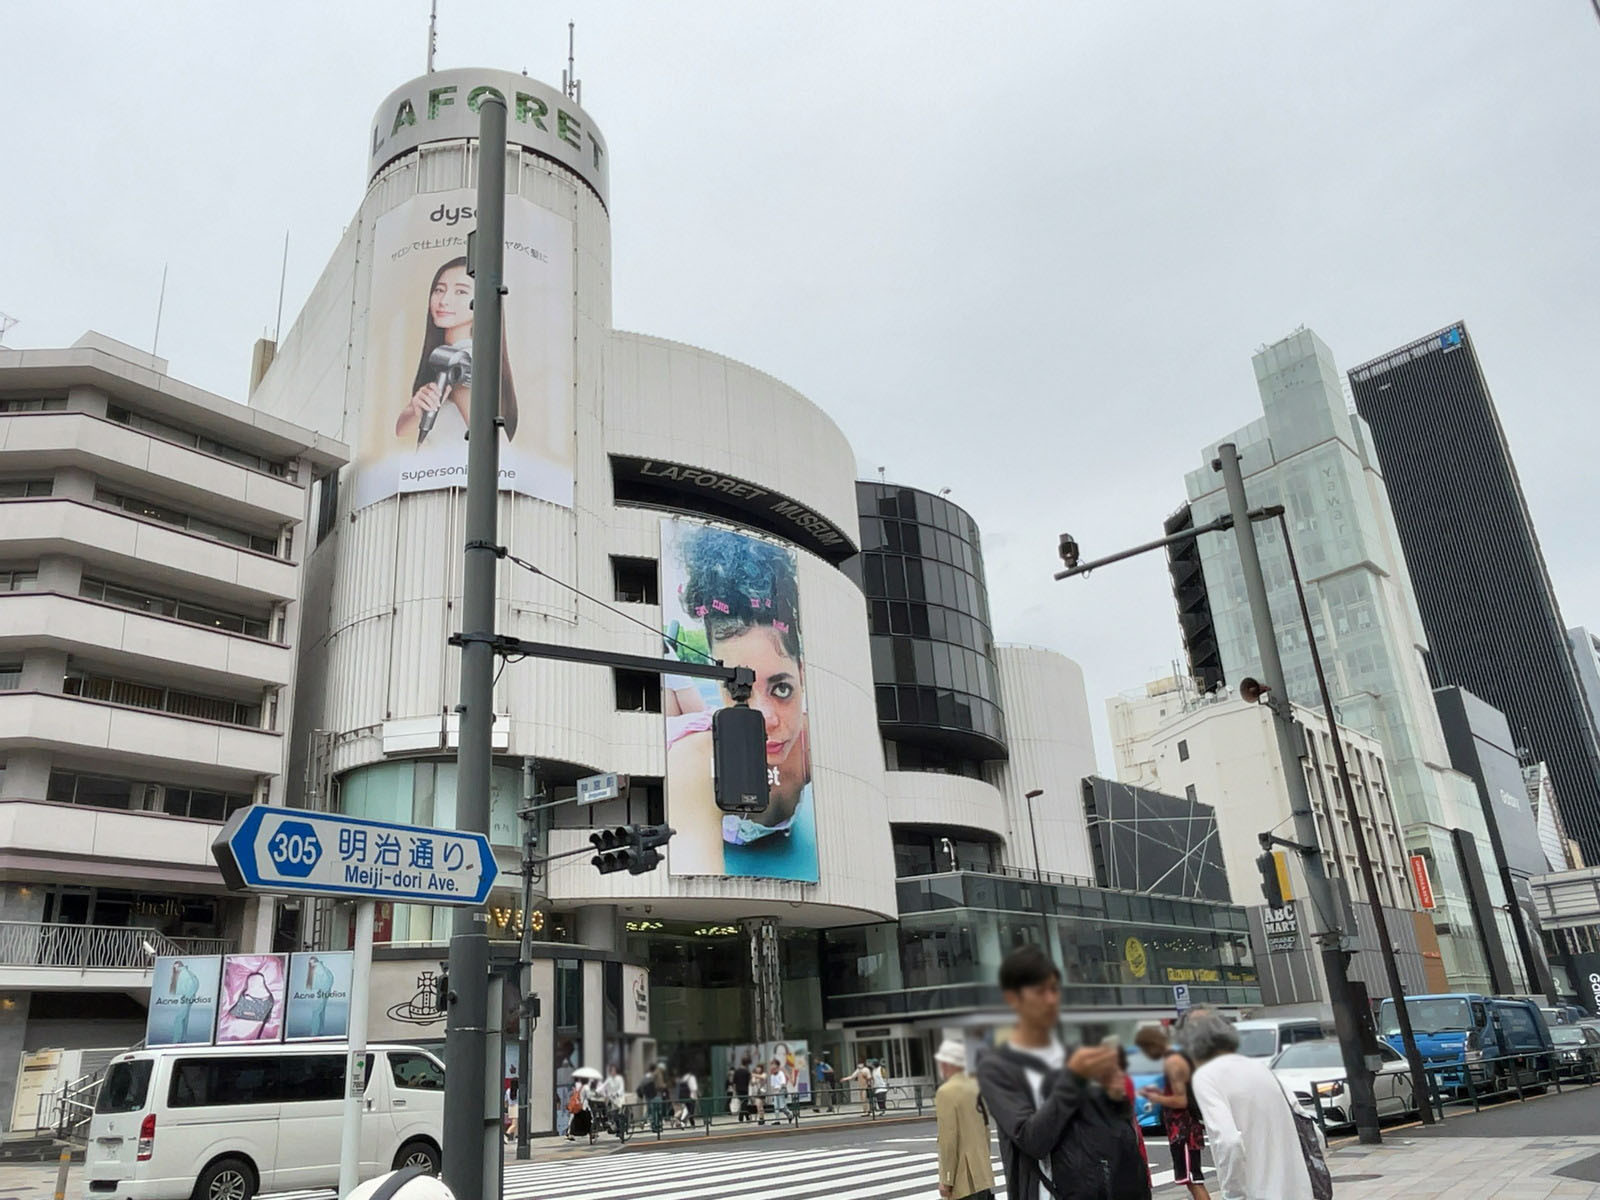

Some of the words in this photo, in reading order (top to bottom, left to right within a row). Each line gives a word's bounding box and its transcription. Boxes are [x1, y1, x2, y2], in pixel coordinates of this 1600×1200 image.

[372, 85, 604, 172] LAFORET
[430, 204, 477, 226] dys
[401, 464, 468, 482] supersoni
[640, 461, 769, 501] LAFORET
[770, 500, 844, 547] MUSEUM
[273, 832, 317, 865] 305
[338, 828, 464, 872] 明治通り
[345, 864, 422, 889] Meiji-dori
[428, 876, 459, 892] Ave.
[1264, 904, 1294, 923] ABC
[1265, 920, 1296, 934] MART
[155, 996, 178, 1006] Acne
[180, 994, 212, 1005] Studios
[293, 990, 315, 1000] Acne
[316, 988, 346, 999] Studios
